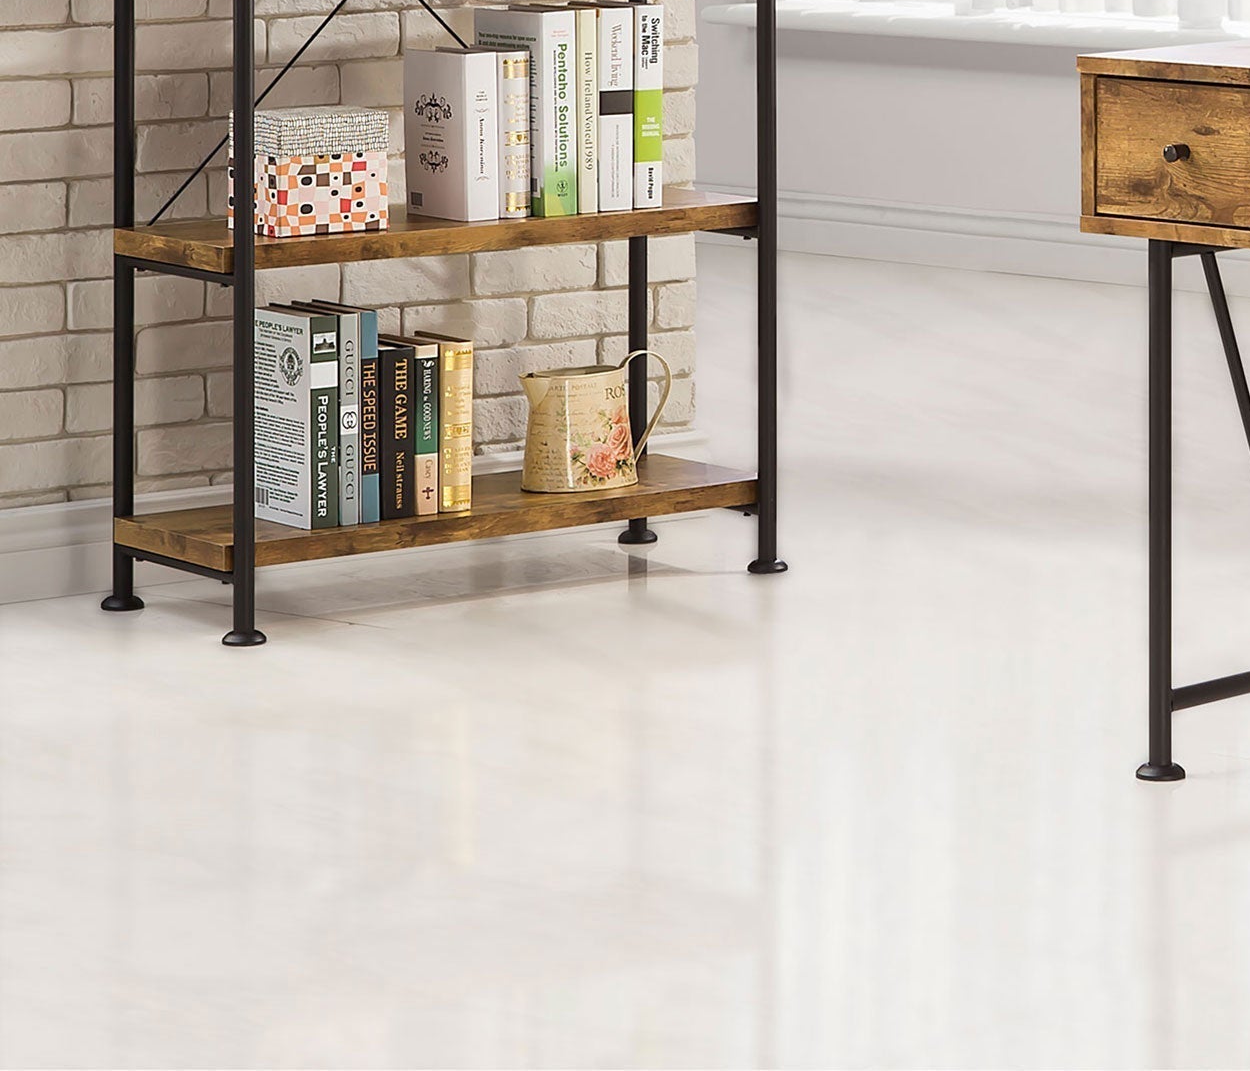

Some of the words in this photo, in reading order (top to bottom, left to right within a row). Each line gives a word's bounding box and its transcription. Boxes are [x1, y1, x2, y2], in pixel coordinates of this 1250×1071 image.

[610, 24, 622, 61] Weekend
[641, 35, 650, 56] Mac
[649, 17, 660, 64] Switching
[557, 43, 568, 99] Pentaho
[584, 52, 593, 77] How
[607, 63, 622, 86] living
[478, 116, 486, 137] Anna
[557, 106, 569, 167] Solutions
[344, 339, 354, 396] GUCCI
[363, 362, 376, 387] THE
[395, 359, 408, 390] THE
[317, 395, 329, 458] PEOPLE'S
[363, 389, 376, 430] SPEED
[394, 393, 408, 440] GAME
[423, 403, 432, 422] GOOD
[423, 422, 432, 440] NEWS
[363, 432, 376, 472] ISSUE
[395, 452, 405, 472] Neil
[423, 459, 433, 479] Casey
[317, 462, 329, 517] LAWYER
[345, 444, 354, 501] GUCCI
